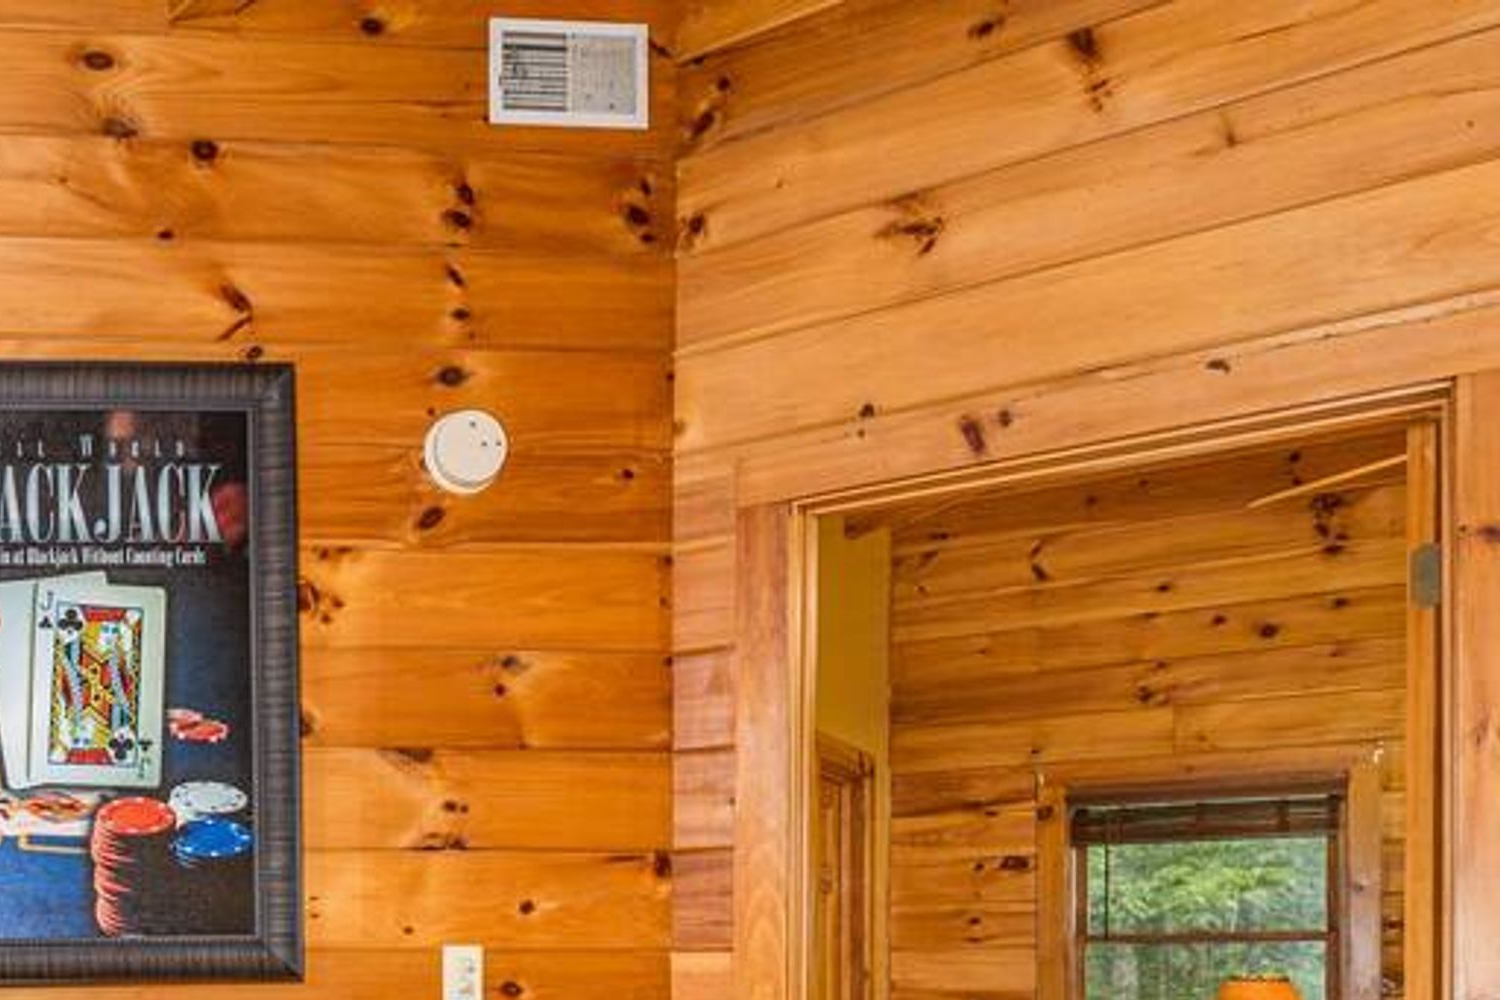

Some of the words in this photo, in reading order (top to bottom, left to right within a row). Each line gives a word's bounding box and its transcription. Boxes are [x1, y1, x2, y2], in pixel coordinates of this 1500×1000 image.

[26, 546, 78, 570] Blackjack
[81, 546, 124, 564] Without
[125, 546, 173, 569] Counting
[175, 546, 207, 565] Cards
